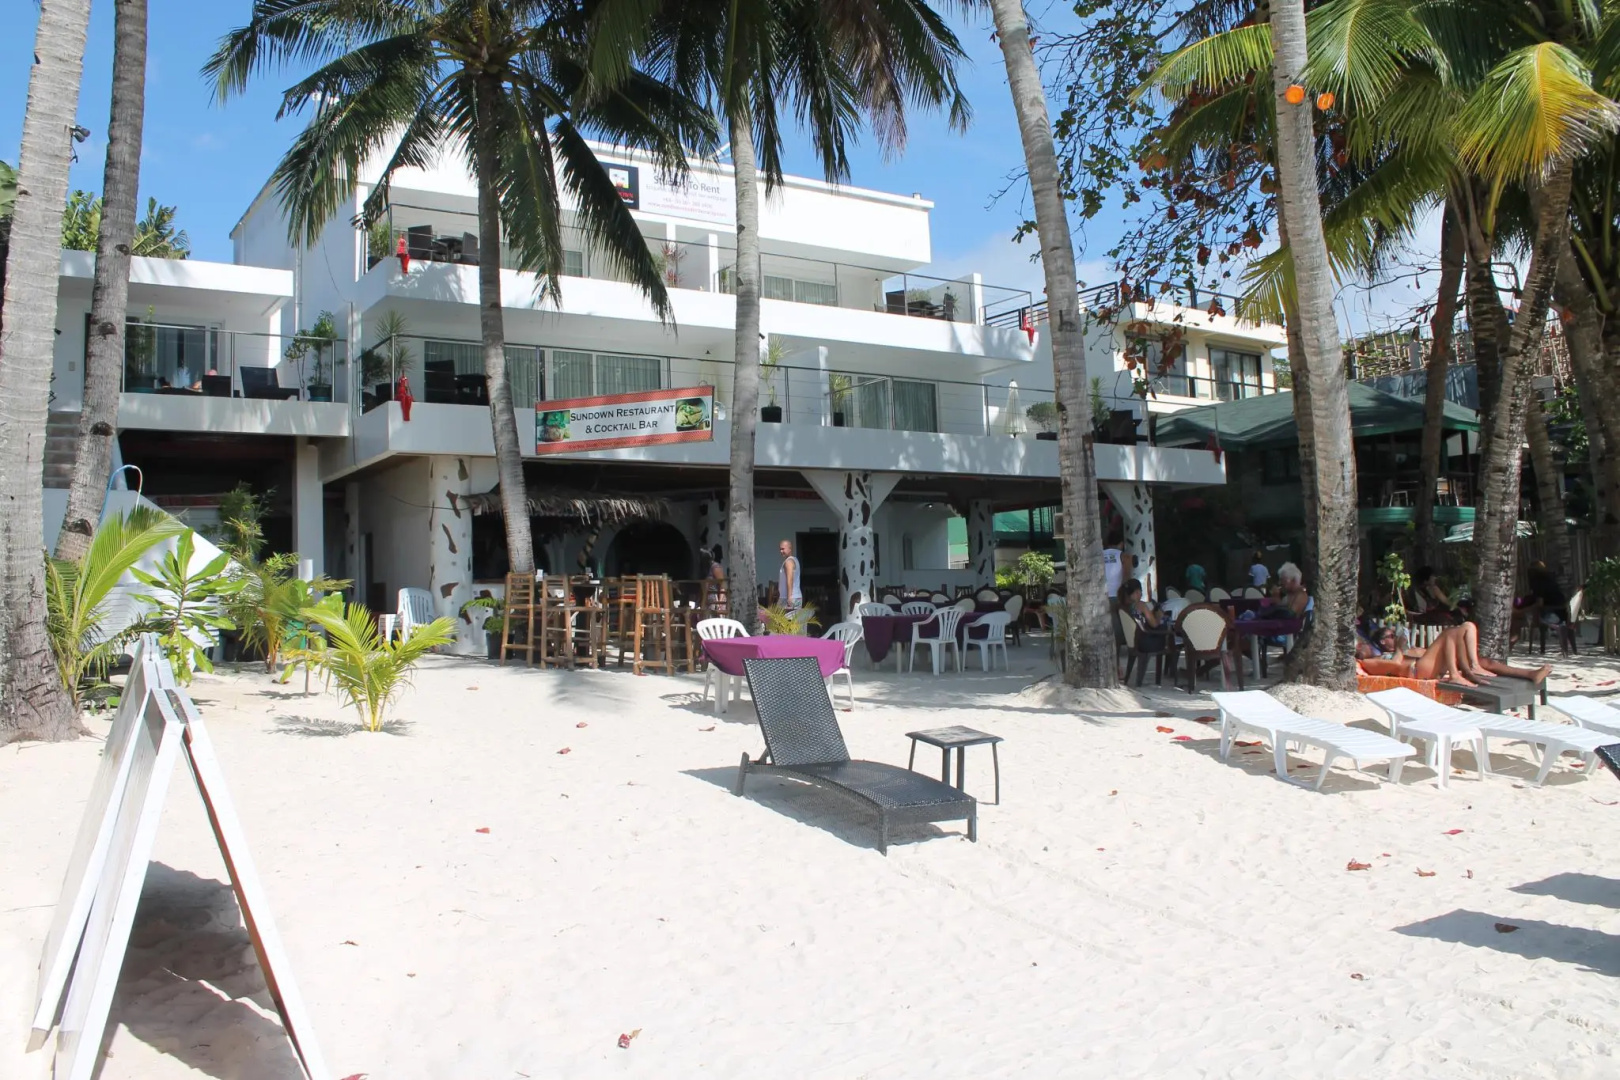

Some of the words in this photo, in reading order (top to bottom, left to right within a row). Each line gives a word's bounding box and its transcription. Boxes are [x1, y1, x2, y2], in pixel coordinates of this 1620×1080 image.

[688, 180, 699, 190] To
[700, 183, 720, 194] Rent
[570, 410, 614, 422] SUNDOWN
[616, 405, 675, 417] RESTAURANT
[585, 425, 593, 434] &
[594, 423, 636, 433] COCKTAIL
[638, 420, 658, 430] BAR
